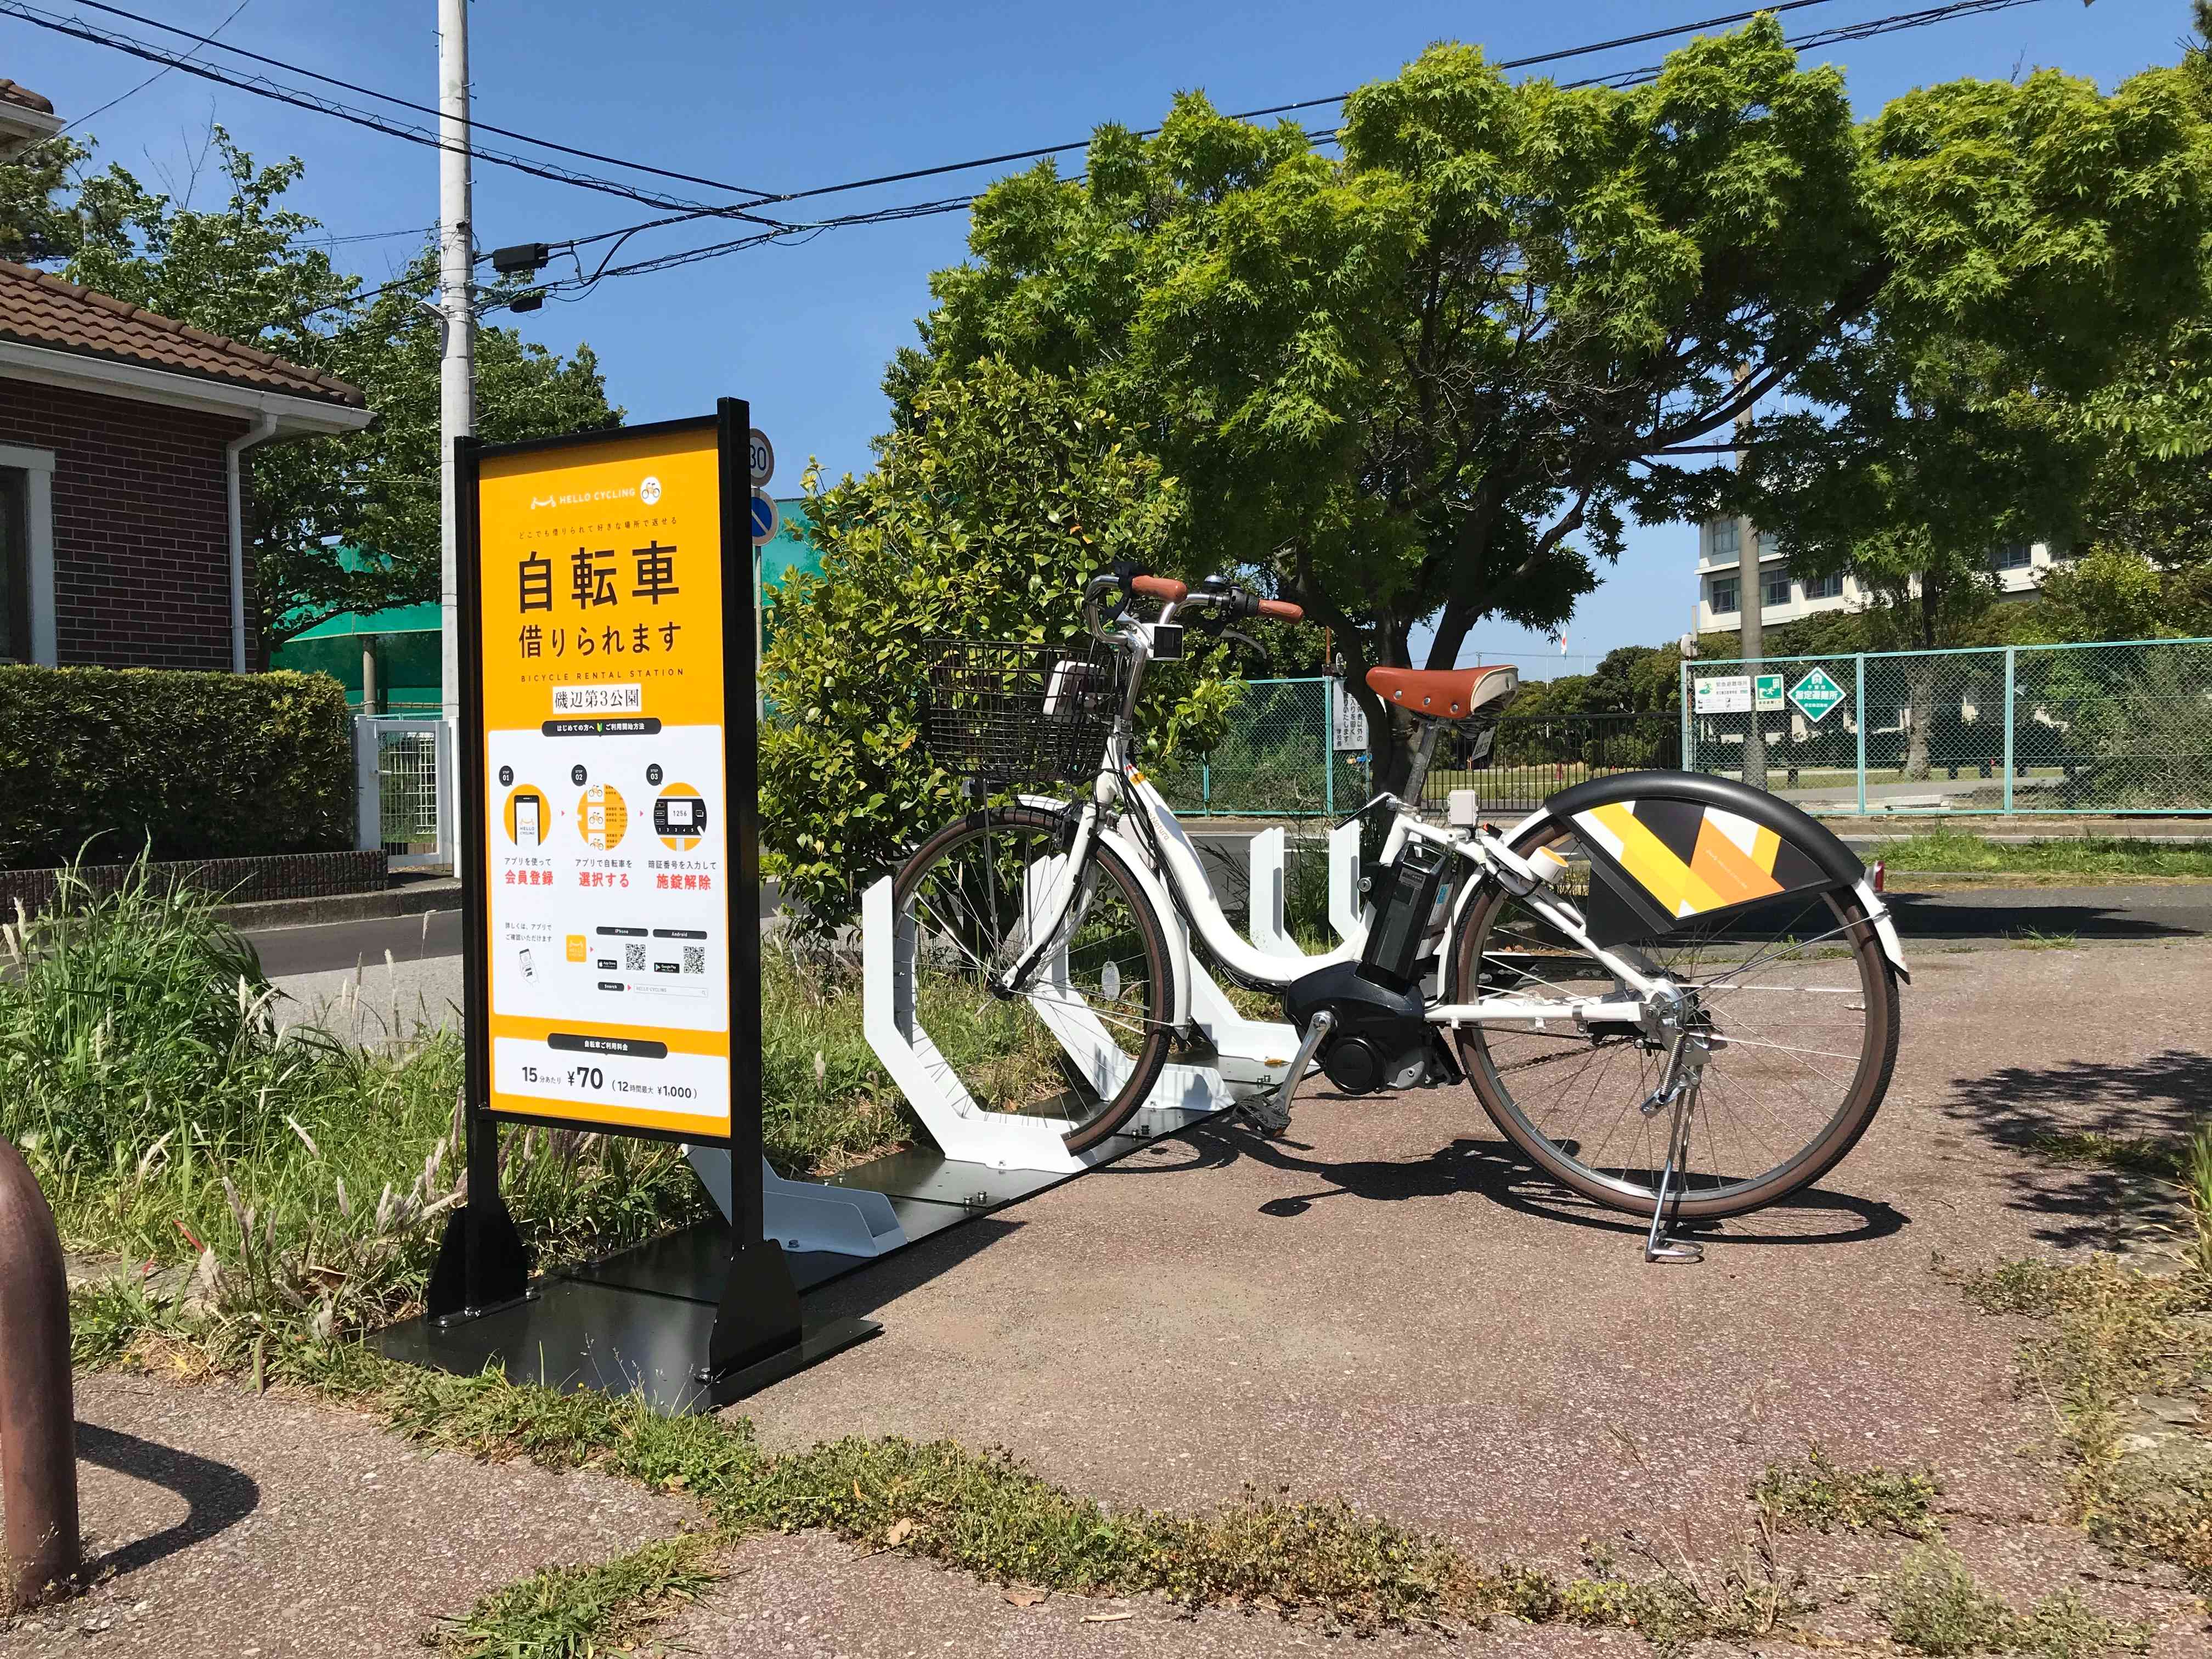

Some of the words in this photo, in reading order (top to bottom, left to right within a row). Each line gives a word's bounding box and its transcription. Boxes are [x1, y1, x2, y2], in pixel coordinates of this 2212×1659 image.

[560, 493, 591, 504] HELLO
[594, 488, 635, 501] CYCLING
[518, 517, 676, 539] どこでも借りられて好きな場所で返せる
[518, 540, 679, 613] 自転車
[518, 622, 681, 658] 借りられます
[521, 673, 568, 682] BICYCLE
[577, 671, 622, 680] RENTAL
[630, 668, 684, 678] STATION
[555, 689, 639, 709] 磯辺第3公園
[1795, 690, 1838, 701] 指定避難所
[557, 723, 595, 732] はじめての方へ
[605, 722, 645, 731] ご利用開始方法
[504, 857, 552, 866] アプリを使って
[575, 859, 633, 868] アプリで自転車を
[648, 860, 717, 870] 暗証番号を入力して
[505, 869, 554, 885] 会員登録
[579, 871, 629, 888] 選択する
[656, 873, 712, 890] 施錠解除
[505, 934, 552, 943] ご確認いただけます
[584, 1040, 628, 1051] 自転車ご利用料金
[567, 1066, 603, 1090] ¥70
